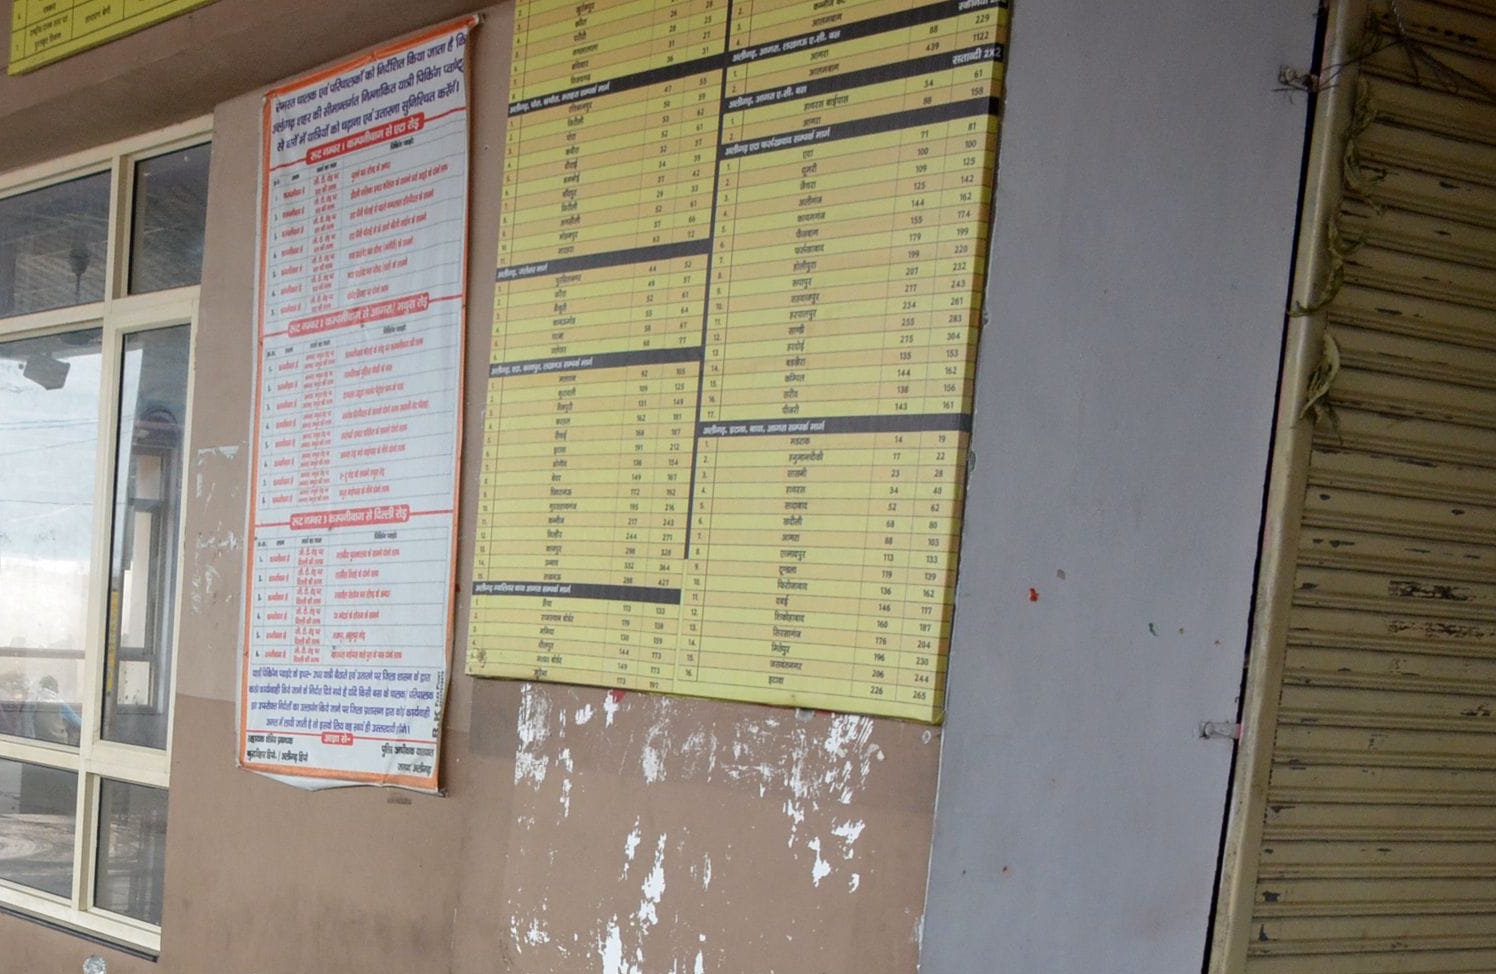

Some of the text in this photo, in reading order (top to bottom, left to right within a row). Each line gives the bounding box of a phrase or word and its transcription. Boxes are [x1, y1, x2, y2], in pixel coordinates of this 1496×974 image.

[929, 25, 937, 33] 88
[975, 13, 989, 24] 229
[925, 41, 939, 51] 439
[973, 31, 989, 40] 1122
[406, 50, 424, 65] किया
[924, 79, 933, 88] 34
[973, 68, 982, 78] 61
[920, 129, 928, 138] 71
[967, 121, 976, 130] 81
[917, 139, 976, 155] 100 100
[962, 156, 975, 165] 125
[960, 174, 974, 182] 142
[911, 198, 924, 206] 144
[959, 191, 971, 201] 162
[956, 227, 968, 235] 199
[908, 244, 968, 258] 199 220
[952, 261, 966, 271] 232
[899, 334, 913, 343] 275
[944, 365, 957, 374] 162
[894, 400, 953, 410] 143 161
[895, 434, 946, 443] 14 19
[892, 452, 900, 460] 17
[935, 451, 945, 460] 22
[889, 486, 898, 494] 34
[888, 502, 896, 511] 52
[930, 503, 939, 512] 62
[883, 553, 894, 561] 113
[880, 586, 891, 595] 136
[922, 589, 934, 597] 162
[917, 639, 930, 648] 204
[915, 656, 928, 665] 230
[914, 673, 928, 682] 244
[870, 685, 883, 695] 226
